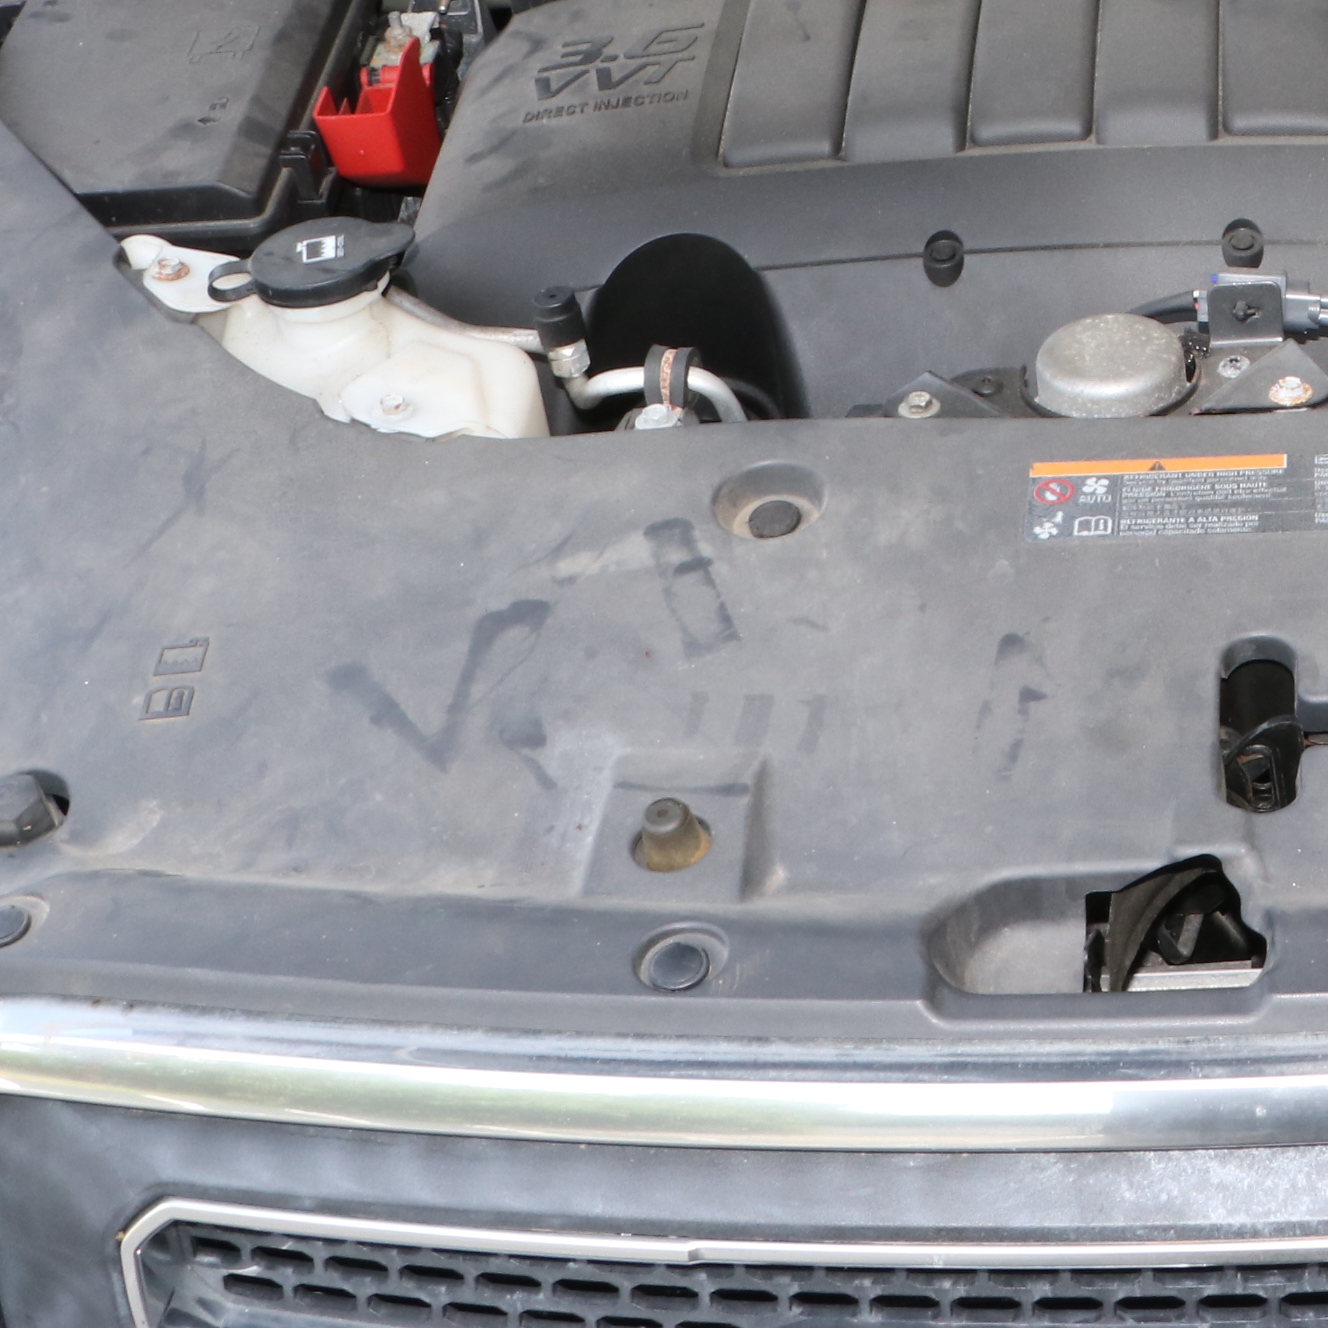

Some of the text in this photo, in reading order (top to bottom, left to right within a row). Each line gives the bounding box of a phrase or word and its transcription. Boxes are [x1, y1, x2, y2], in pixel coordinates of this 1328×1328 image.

[537, 23, 705, 73] 3.6
[535, 56, 696, 101] VVT
[522, 89, 689, 123] DIRECT INJECTION
[1079, 494, 1112, 503] AUTO
